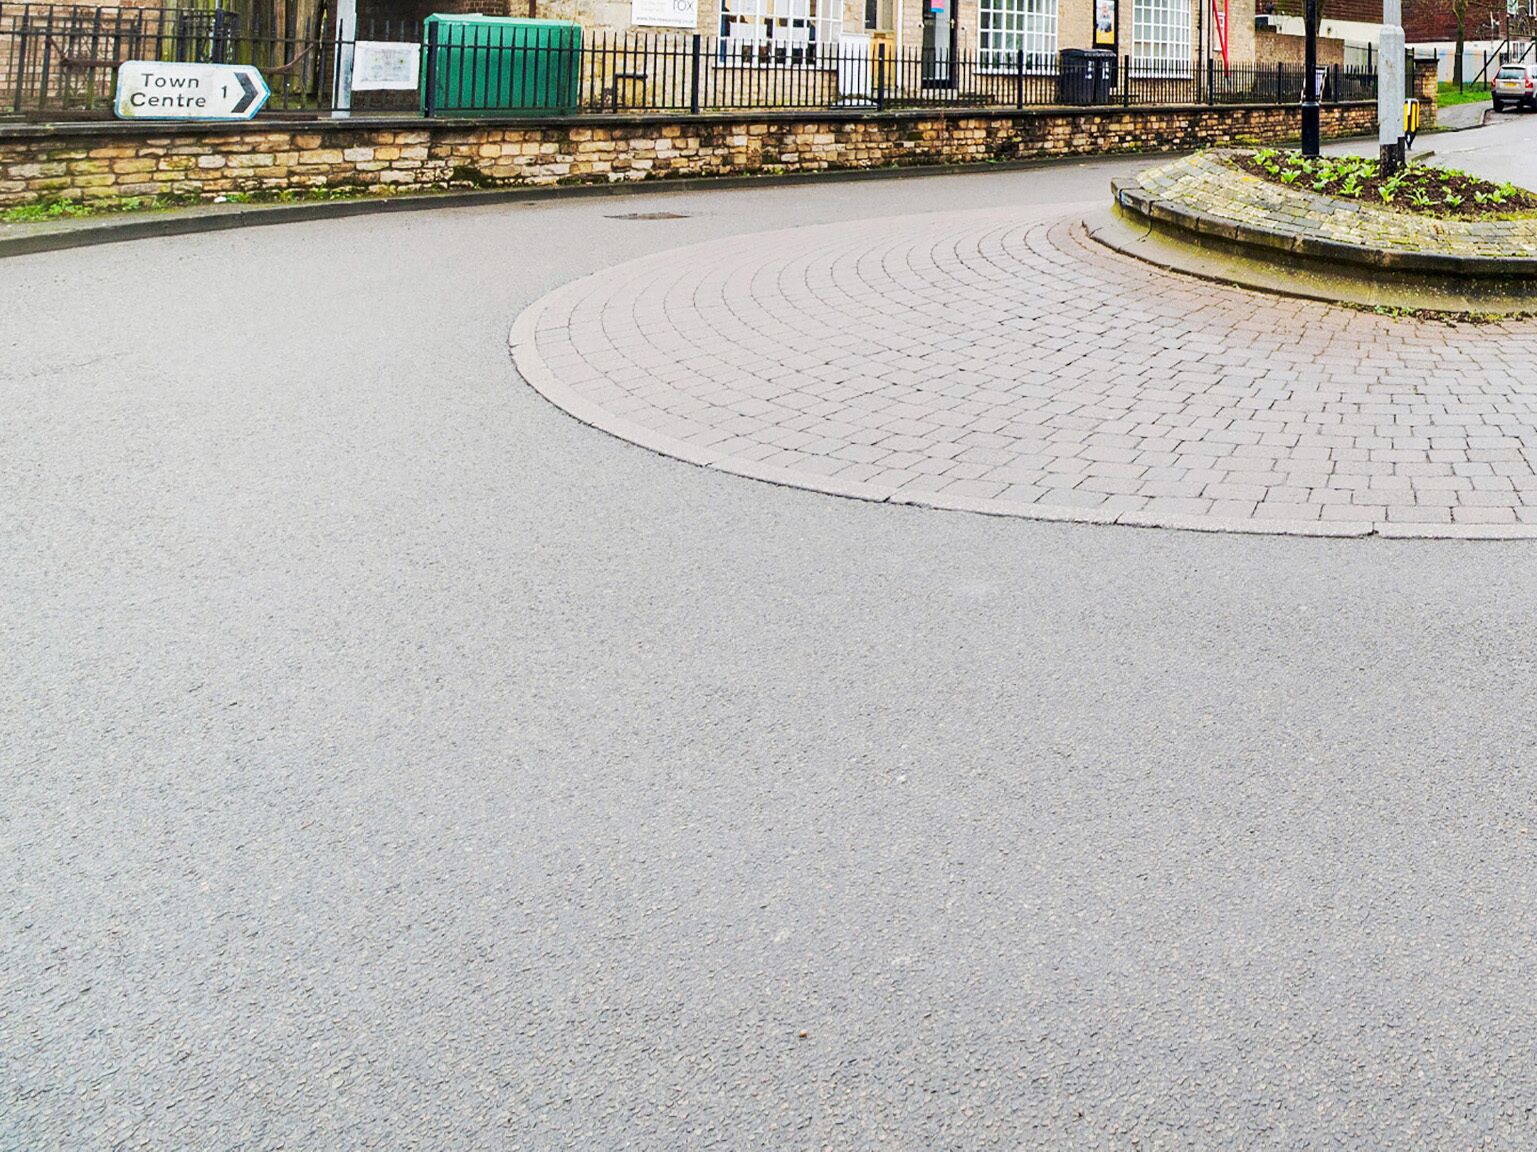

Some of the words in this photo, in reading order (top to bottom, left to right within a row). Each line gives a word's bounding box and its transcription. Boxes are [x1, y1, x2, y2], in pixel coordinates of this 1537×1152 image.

[141, 73, 199, 88] Town
[130, 92, 207, 108] Centre
[220, 85, 228, 99] 1
